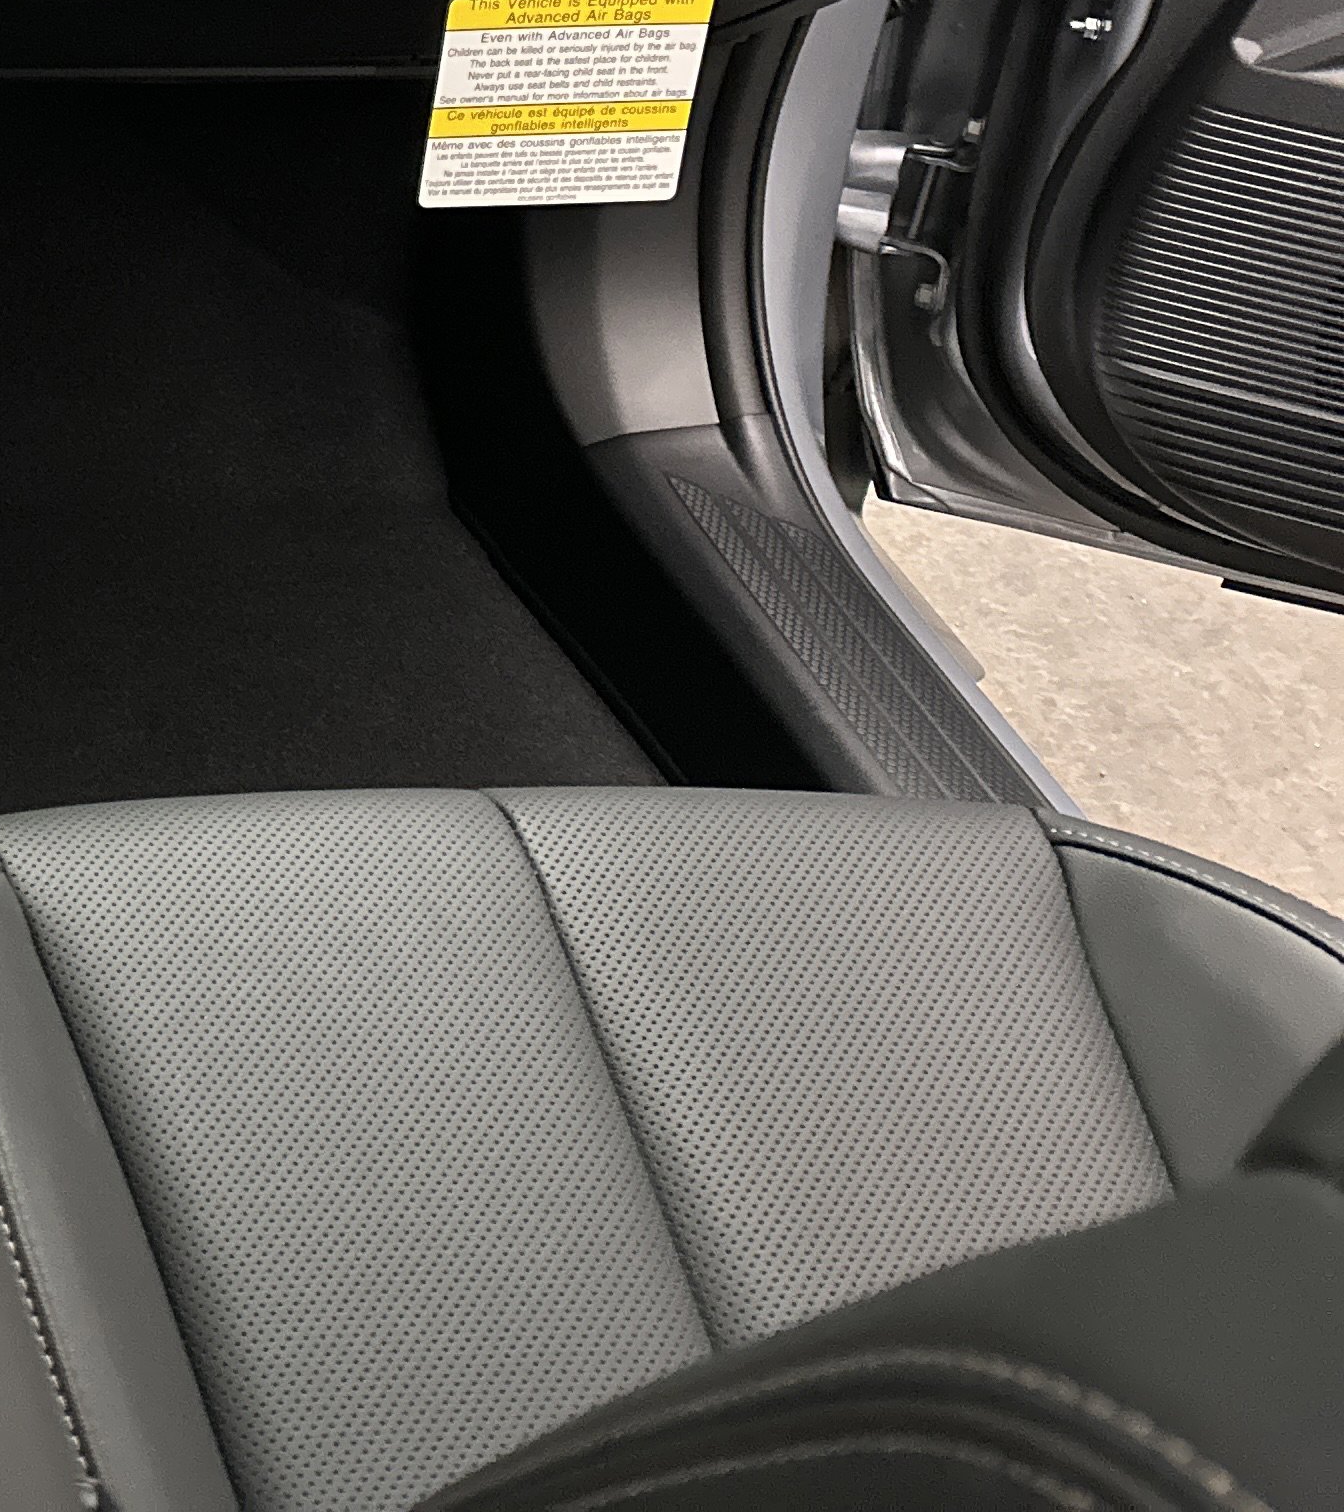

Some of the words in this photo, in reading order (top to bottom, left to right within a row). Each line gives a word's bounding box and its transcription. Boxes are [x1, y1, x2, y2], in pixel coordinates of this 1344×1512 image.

[505, 10, 580, 23] Advanced
[585, 9, 608, 21] Air
[612, 7, 652, 25] Bags
[480, 32, 513, 42] Even
[517, 31, 543, 41] with
[547, 29, 611, 40] Advanced
[614, 28, 634, 38] Air
[637, 27, 671, 40] Bags
[446, 47, 484, 56] Children
[485, 47, 503, 55] can
[505, 46, 518, 55] be
[520, 45, 544, 54] killed
[599, 43, 630, 53] injured
[632, 42, 644, 52] by
[646, 42, 662, 50] the
[663, 41, 676, 50] air
[678, 40, 697, 51] bag.
[446, 110, 466, 120] Ce
[469, 108, 523, 119] véhicule
[527, 107, 548, 118] est
[551, 106, 596, 119] équipé
[599, 105, 616, 115] de
[620, 103, 677, 115] coussins
